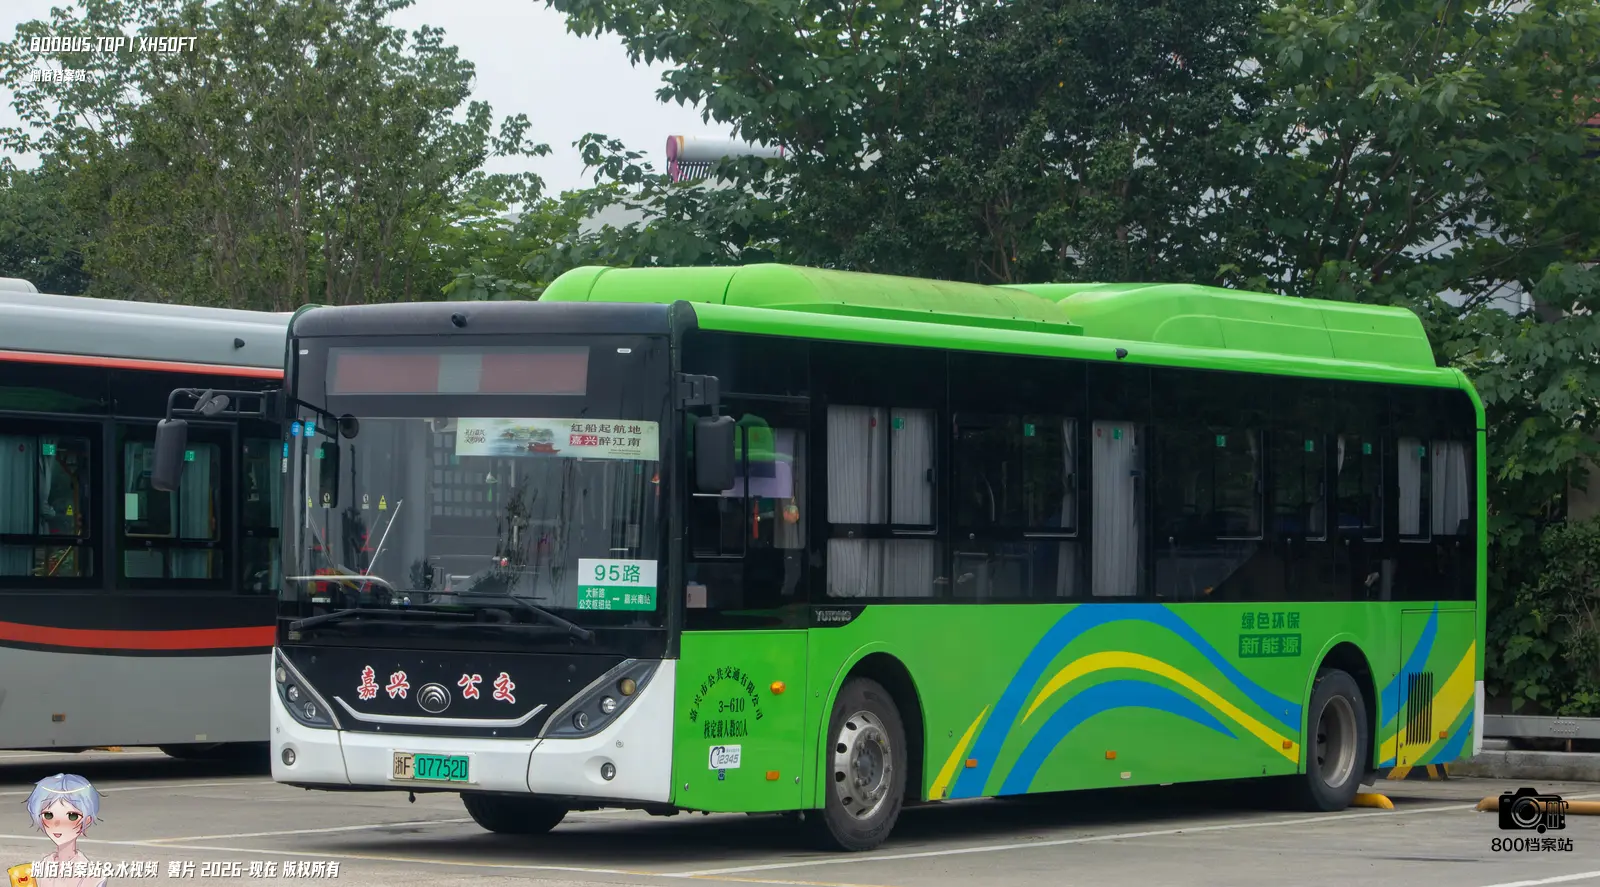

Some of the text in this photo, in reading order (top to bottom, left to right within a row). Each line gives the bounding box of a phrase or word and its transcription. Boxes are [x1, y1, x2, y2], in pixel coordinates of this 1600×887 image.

[570, 423, 642, 435] 红船起航地
[594, 564, 641, 583] 95路
[585, 587, 606, 598] 大新路
[624, 593, 651, 605] 嘉兴南站
[579, 599, 612, 610] 公交枢纽站
[1241, 611, 1301, 630] 绿色环保
[1241, 636, 1300, 655] 新能源
[357, 664, 517, 705] 嘉兴 公交
[718, 697, 745, 713] 3-610
[716, 753, 740, 765] 12345
